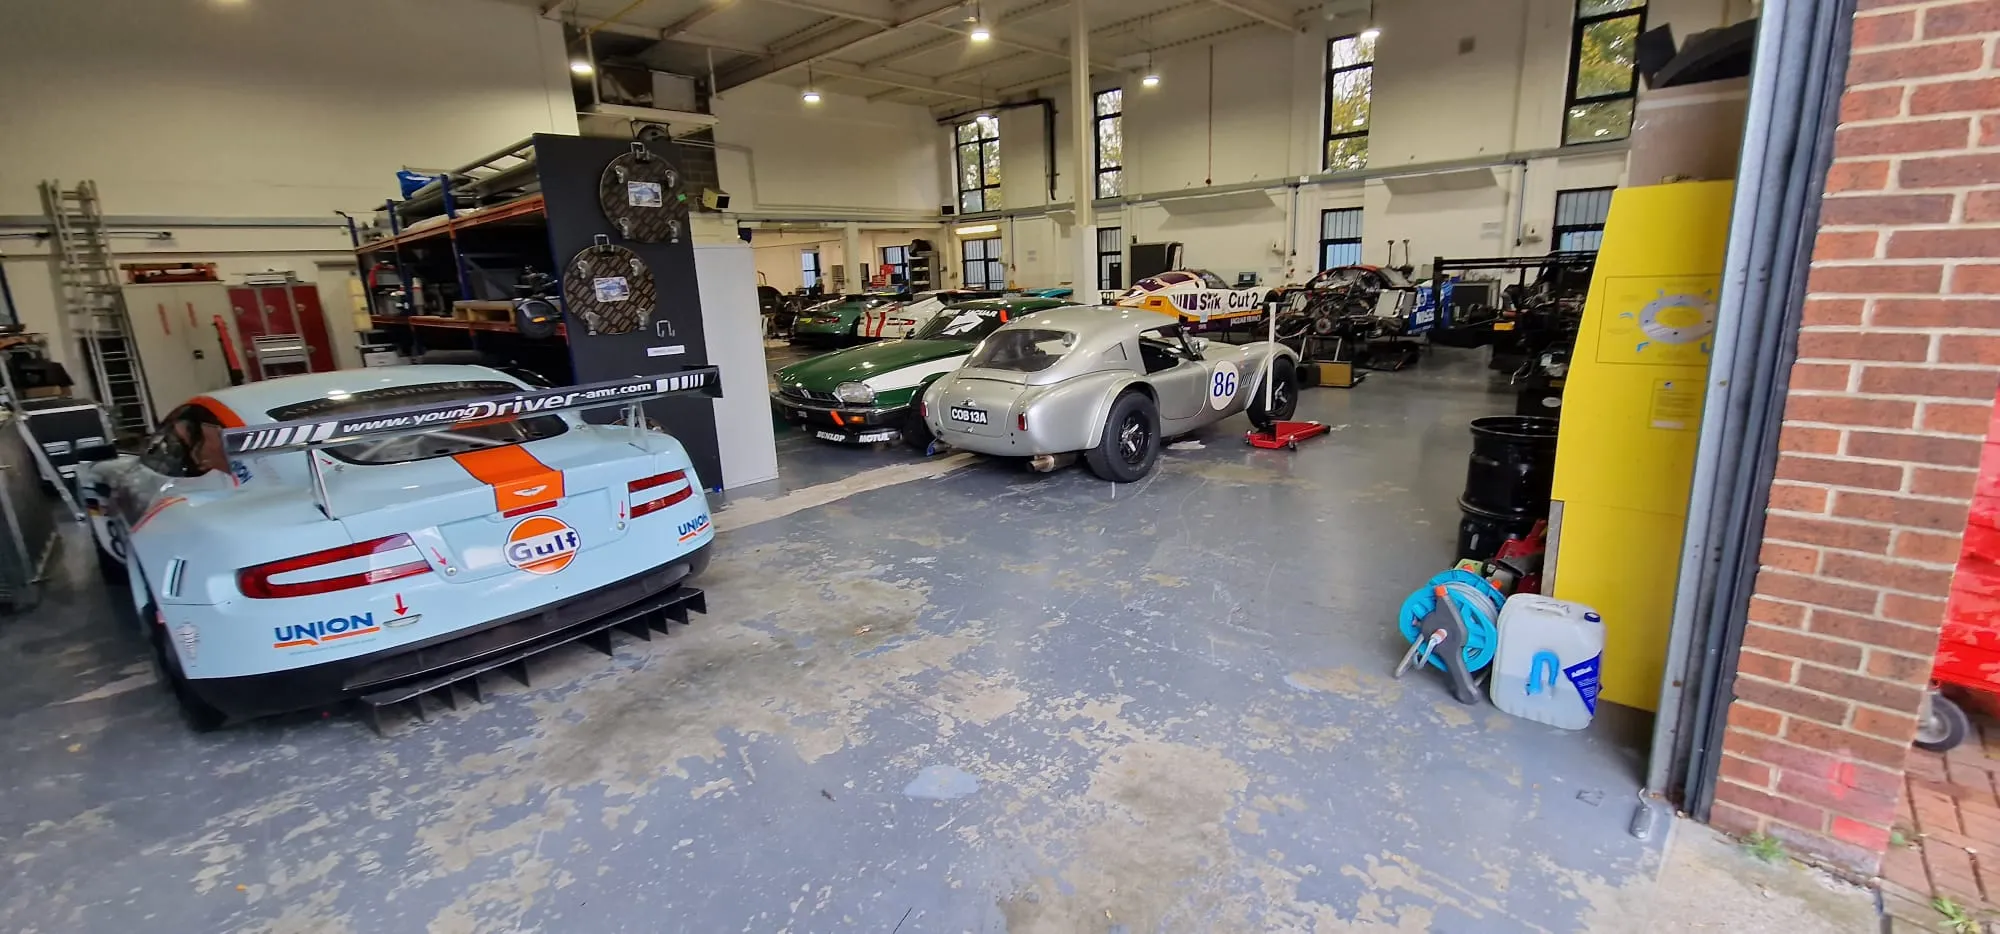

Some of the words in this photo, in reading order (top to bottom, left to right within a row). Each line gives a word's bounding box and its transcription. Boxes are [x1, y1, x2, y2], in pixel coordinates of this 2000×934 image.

[1229, 291, 1249, 308] Cut
[1213, 371, 1235, 397] 86
[343, 382, 652, 433] www.youngDriver-amr.com
[816, 430, 846, 442] DUNLOP
[859, 433, 890, 443] MOTUL
[678, 512, 709, 536] UNION
[508, 531, 578, 562] Gulf
[273, 611, 375, 641] UNION
